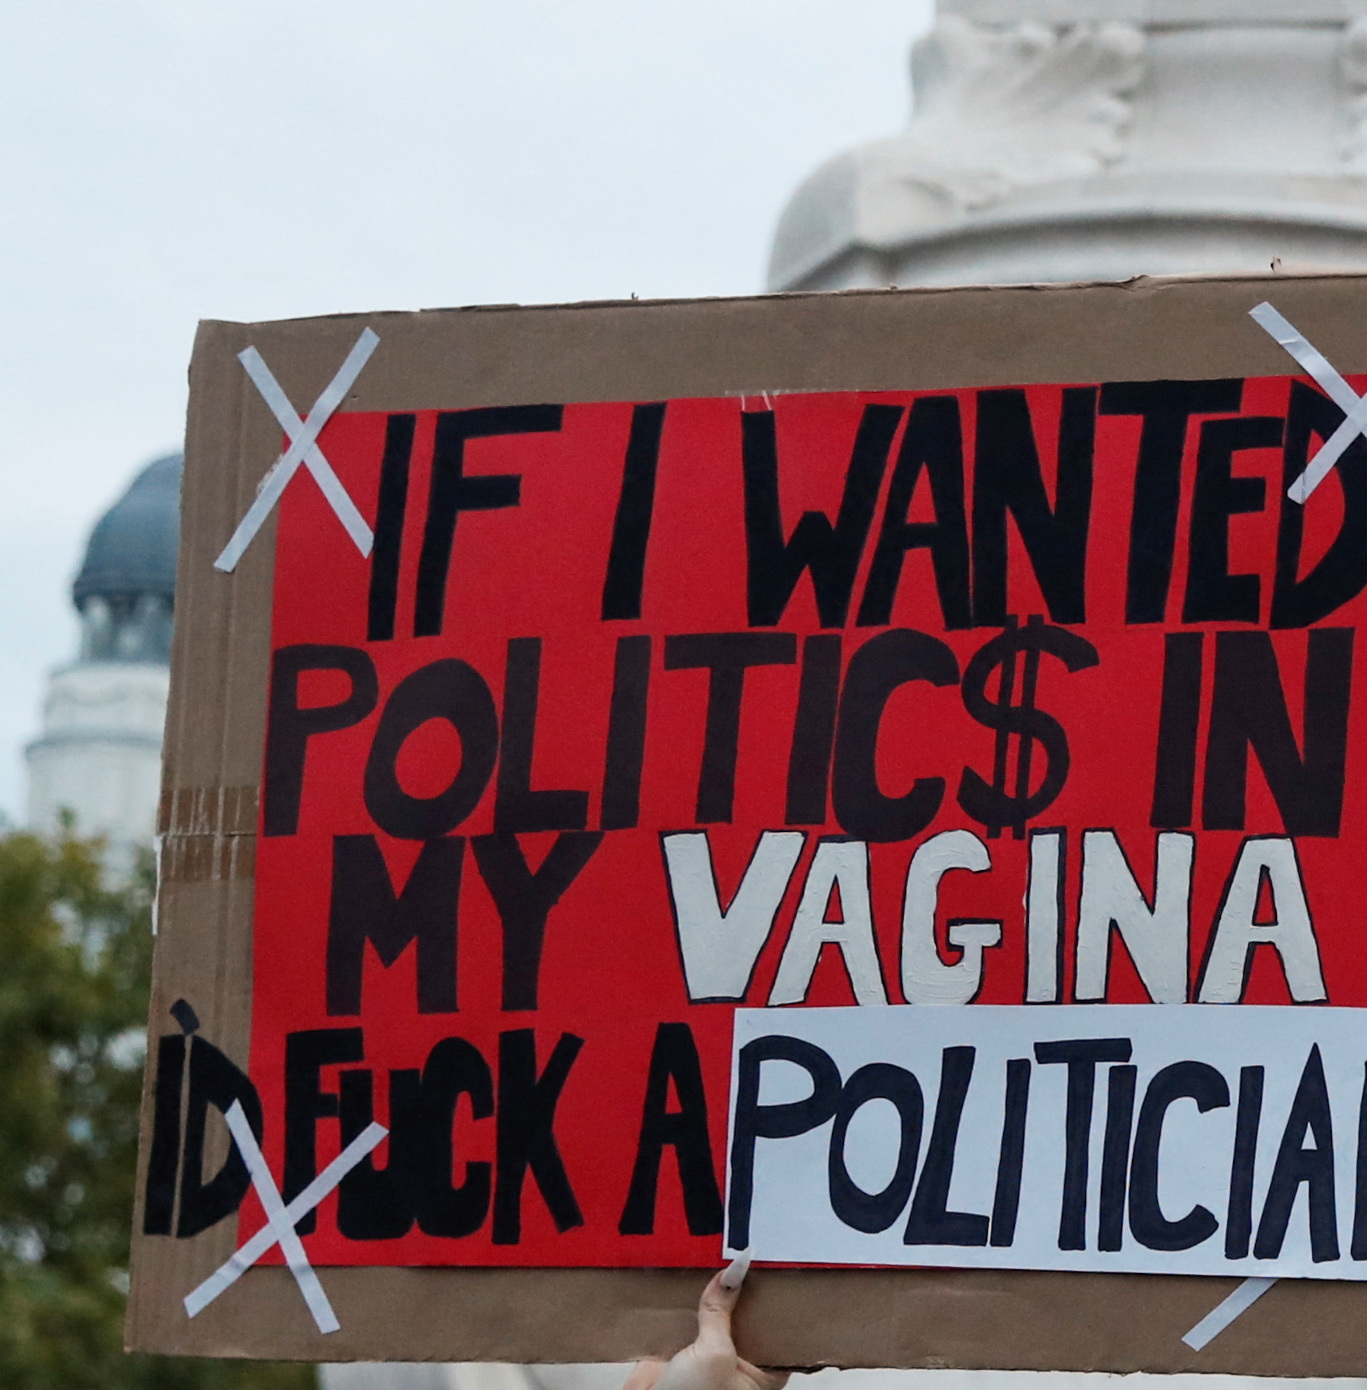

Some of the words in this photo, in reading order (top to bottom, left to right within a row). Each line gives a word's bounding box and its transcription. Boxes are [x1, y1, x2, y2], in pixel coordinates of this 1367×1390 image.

[367, 405, 563, 640] IF
[602, 402, 667, 620] I
[263, 613, 1099, 842] POLITIC$
[1151, 627, 1356, 837] IN
[326, 830, 602, 1016] MY
[661, 827, 1327, 1006] VAGINA
[284, 1027, 586, 1245] FUCK
[618, 1022, 724, 1236] A
